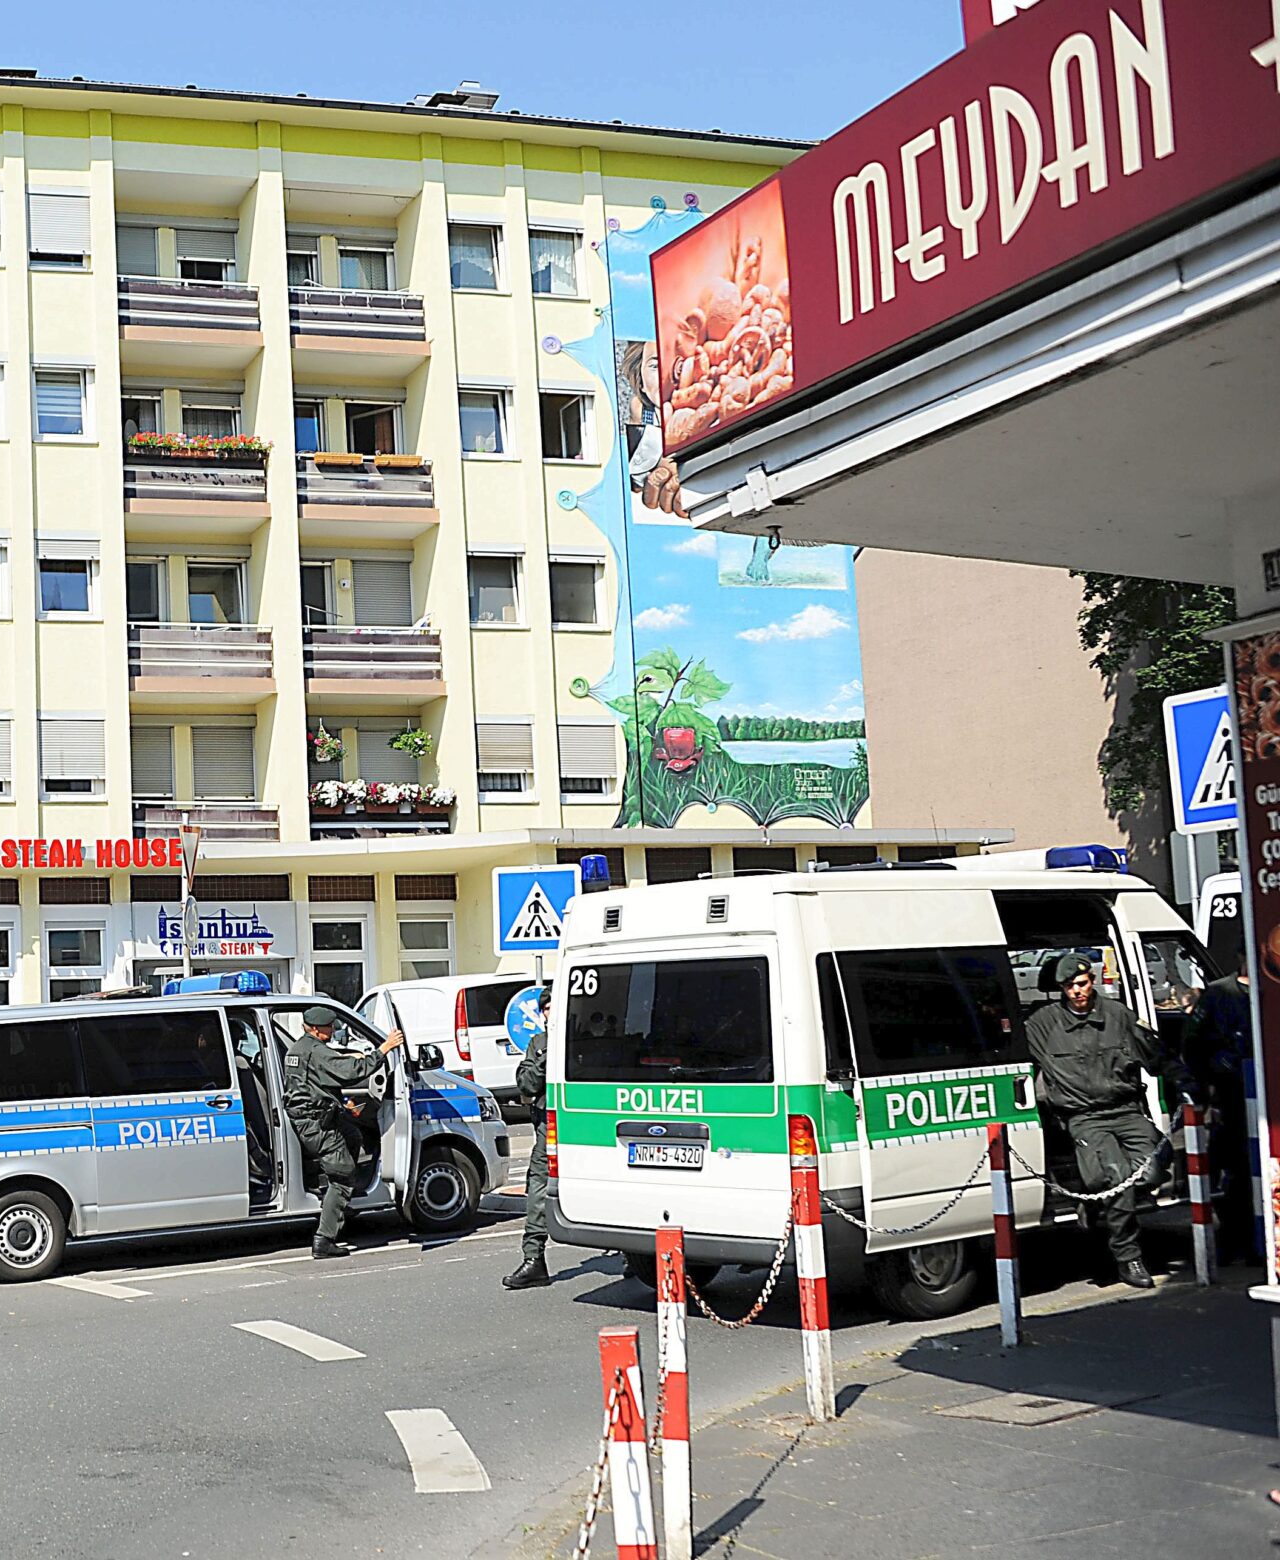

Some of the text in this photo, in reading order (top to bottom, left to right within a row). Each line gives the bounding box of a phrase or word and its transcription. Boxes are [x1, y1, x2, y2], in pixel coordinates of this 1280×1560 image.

[832, 0, 1176, 326] MEYDAN
[0, 838, 83, 868] STEAK
[96, 838, 182, 868] HOUSE
[1212, 897, 1237, 917] 23
[221, 942, 255, 955] STEAK
[569, 969, 599, 996] 26
[616, 1088, 704, 1113] POLIZEI
[886, 1083, 997, 1128] POLIZEI
[118, 1116, 217, 1144] POLIZEI
[635, 1146, 655, 1163] NRW
